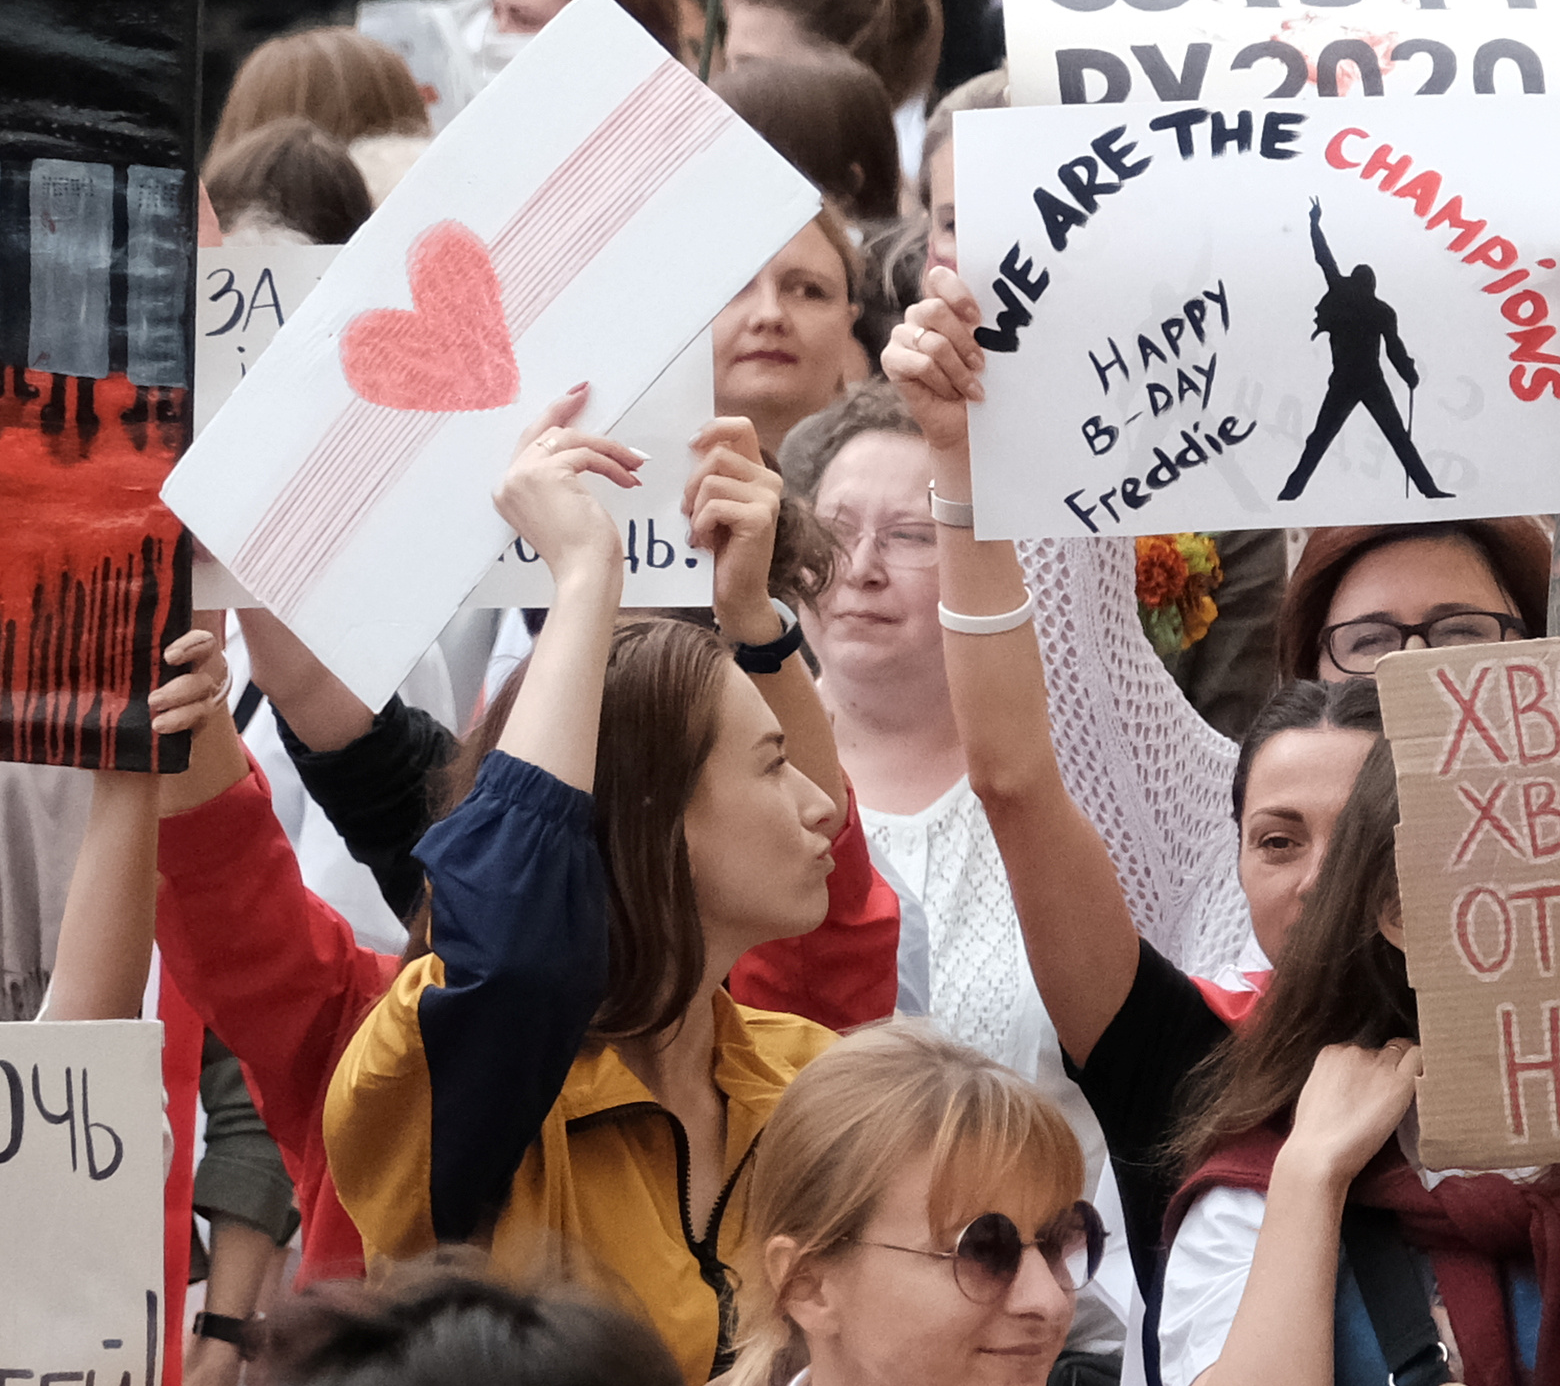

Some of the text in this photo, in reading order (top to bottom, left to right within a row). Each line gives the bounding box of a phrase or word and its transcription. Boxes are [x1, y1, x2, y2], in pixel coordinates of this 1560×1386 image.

[974, 240, 1051, 353] WE
[1032, 124, 1153, 252] ARE
[1149, 108, 1309, 161] THE
[205, 267, 285, 337] ЗА
[1088, 279, 1230, 395] HAPPY
[1064, 414, 1256, 533] Freddie
